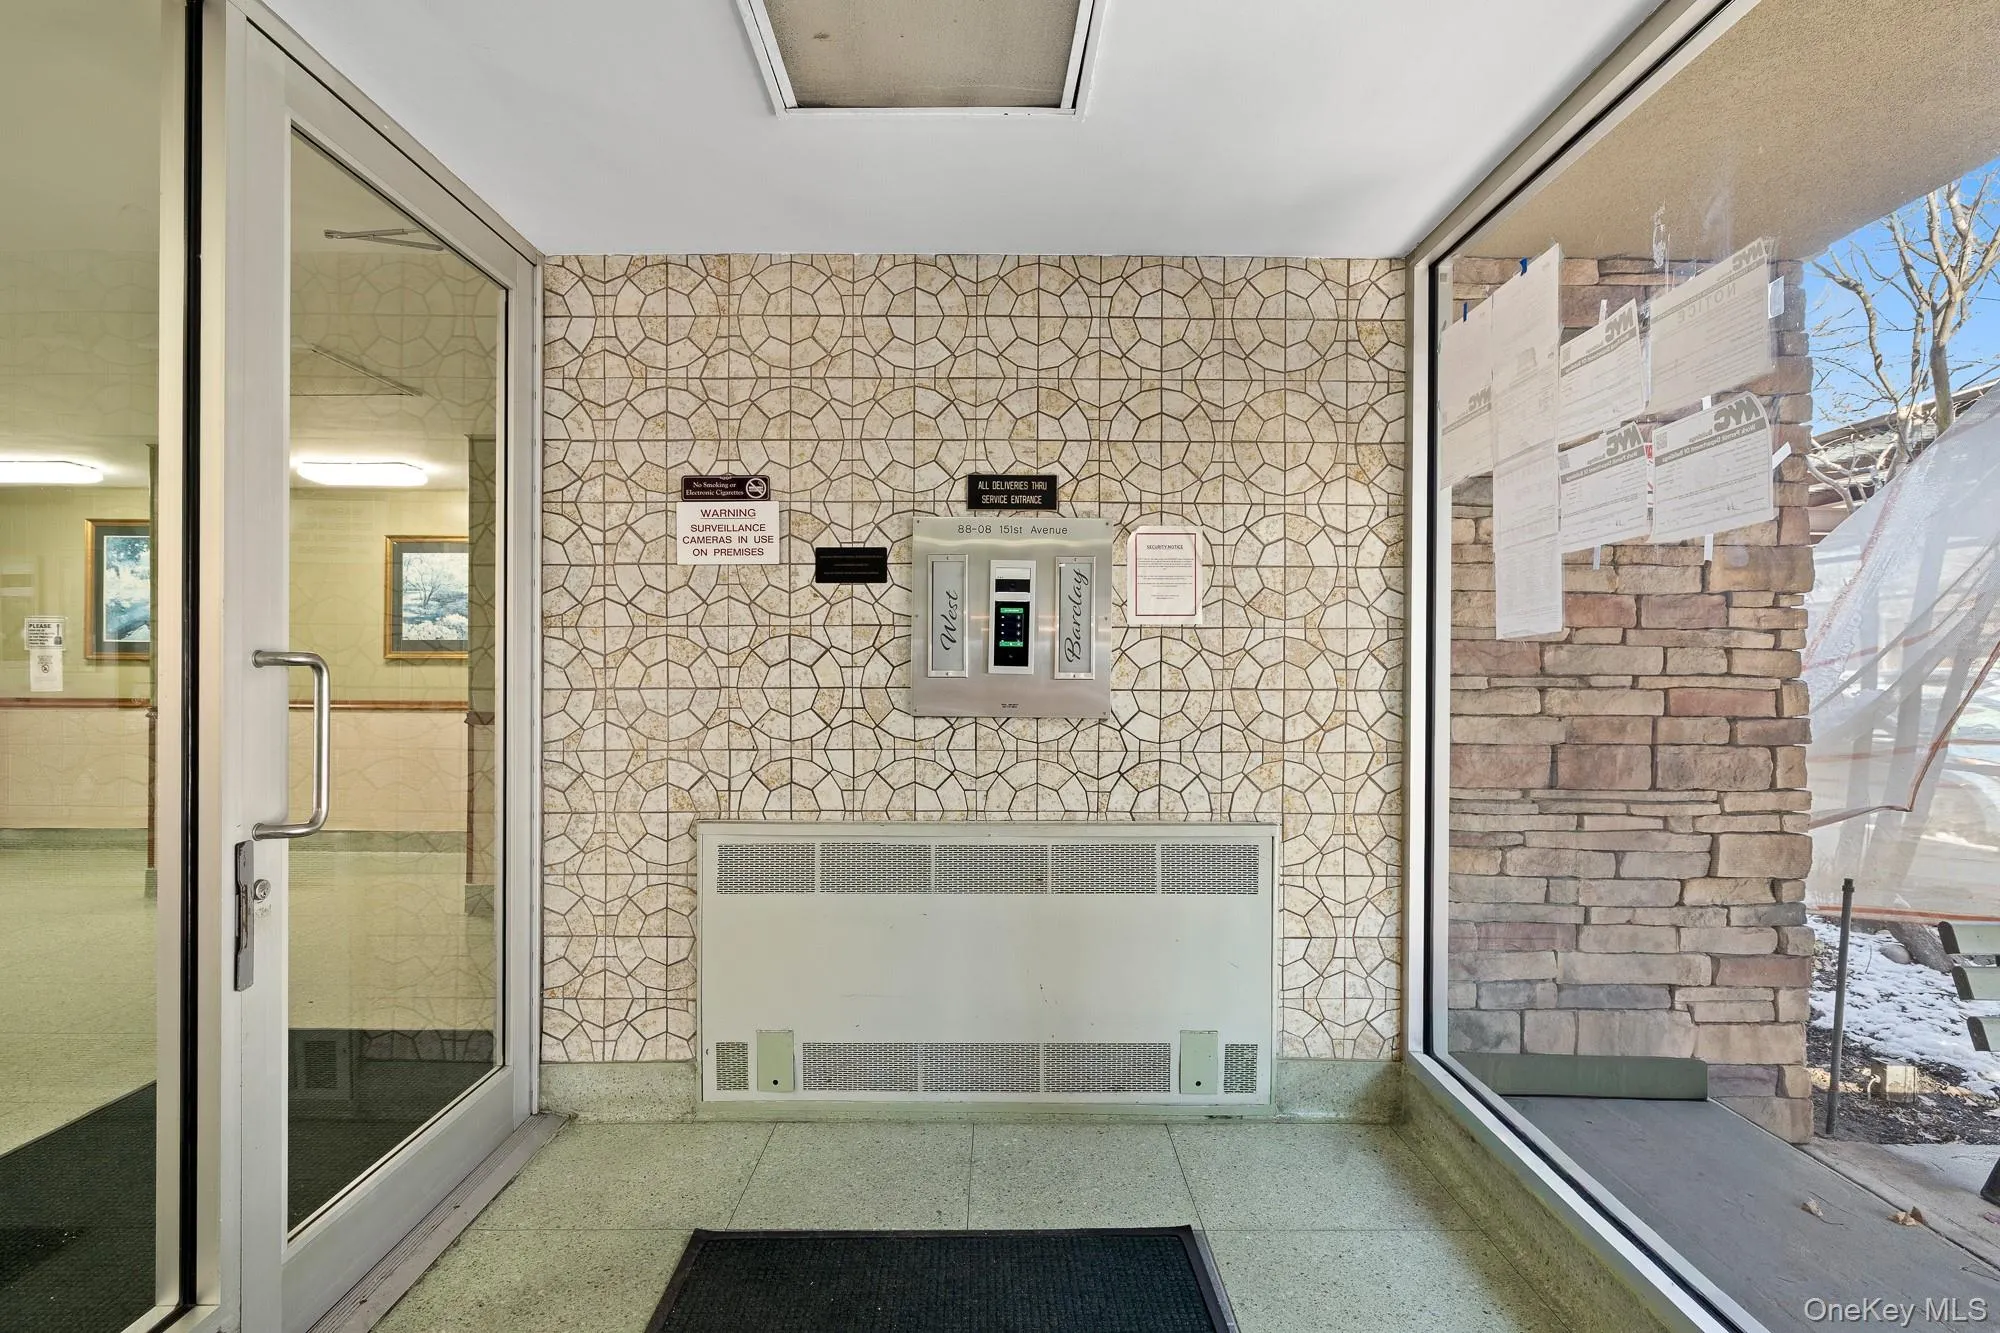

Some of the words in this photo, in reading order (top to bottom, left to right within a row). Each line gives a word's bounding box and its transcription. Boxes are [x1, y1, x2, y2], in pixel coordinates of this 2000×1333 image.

[978, 481, 990, 490] ALL
[992, 481, 1029, 490] DELIVERIES
[1031, 481, 1047, 490] THRU
[982, 495, 1008, 504] SERVICE
[1011, 495, 1042, 505] ENTRANCE
[701, 509, 756, 517] WARNING
[690, 524, 766, 532] SURVEILLANCE
[958, 525, 991, 533] 88-08
[1000, 525, 1022, 534] 151st
[1030, 526, 1068, 534] Avenue
[682, 536, 732, 544] CAMERAS
[738, 536, 748, 544] IN
[754, 535, 774, 544] USE
[714, 548, 764, 556] PREMISES
[940, 589, 959, 651] West
[1064, 568, 1089, 663] Barclay
